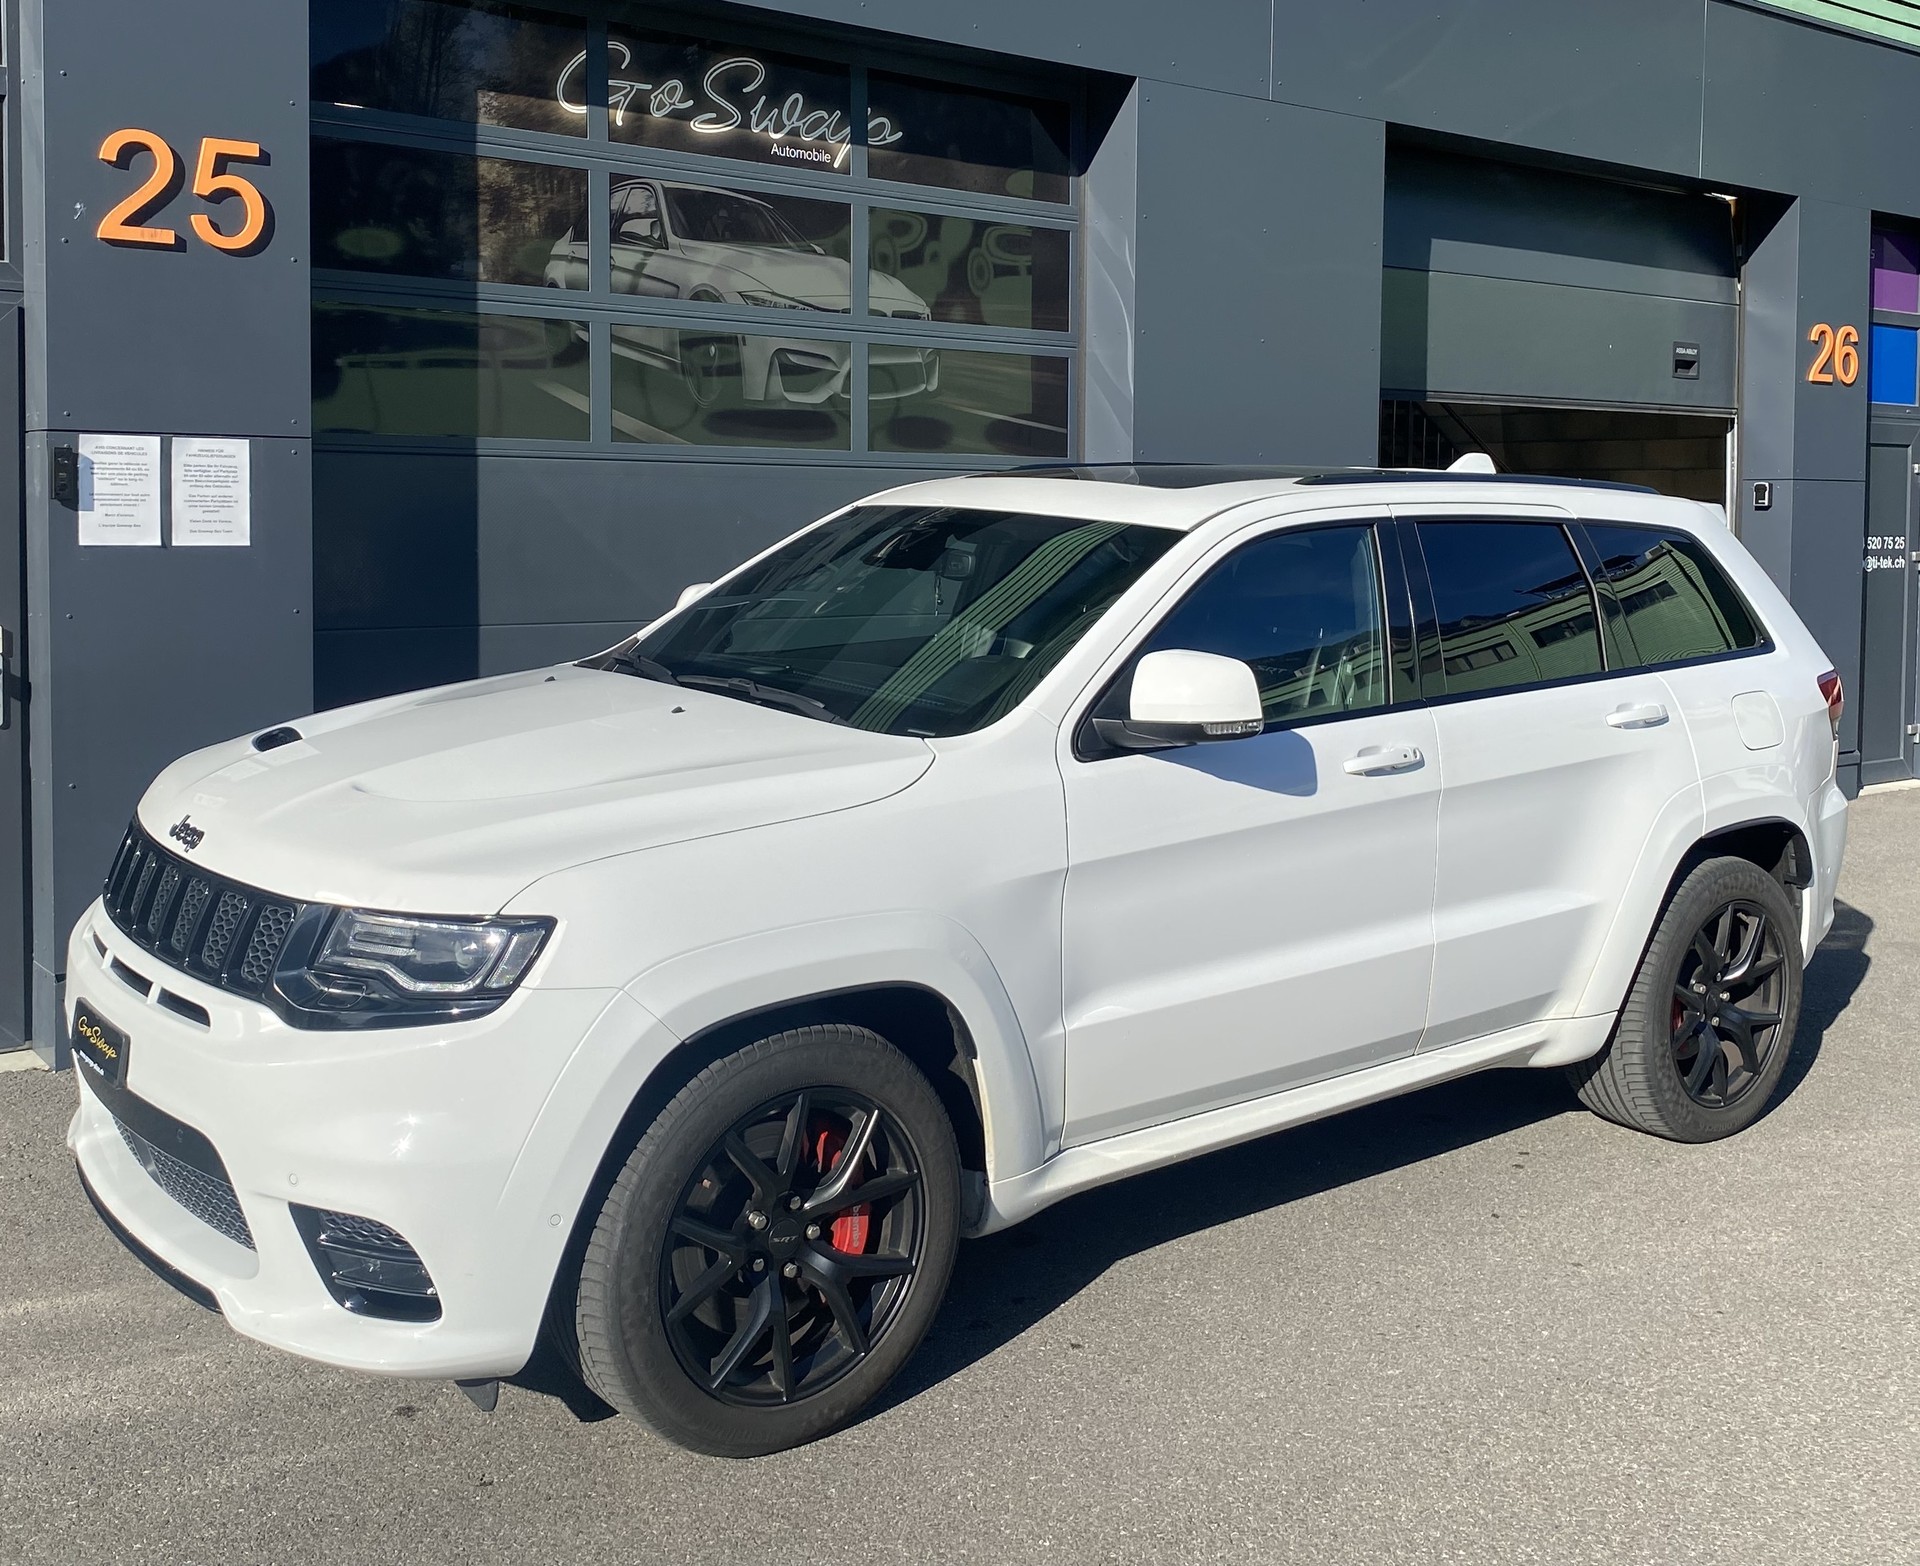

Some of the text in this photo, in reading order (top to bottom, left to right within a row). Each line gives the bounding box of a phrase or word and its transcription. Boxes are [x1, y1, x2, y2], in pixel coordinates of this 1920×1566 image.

[770, 142, 832, 164] Automobile
[97, 128, 265, 250] 25
[1807, 323, 1859, 384] 26
[1867, 536, 1905, 550] 520 75 25
[169, 814, 205, 853] Jeep
